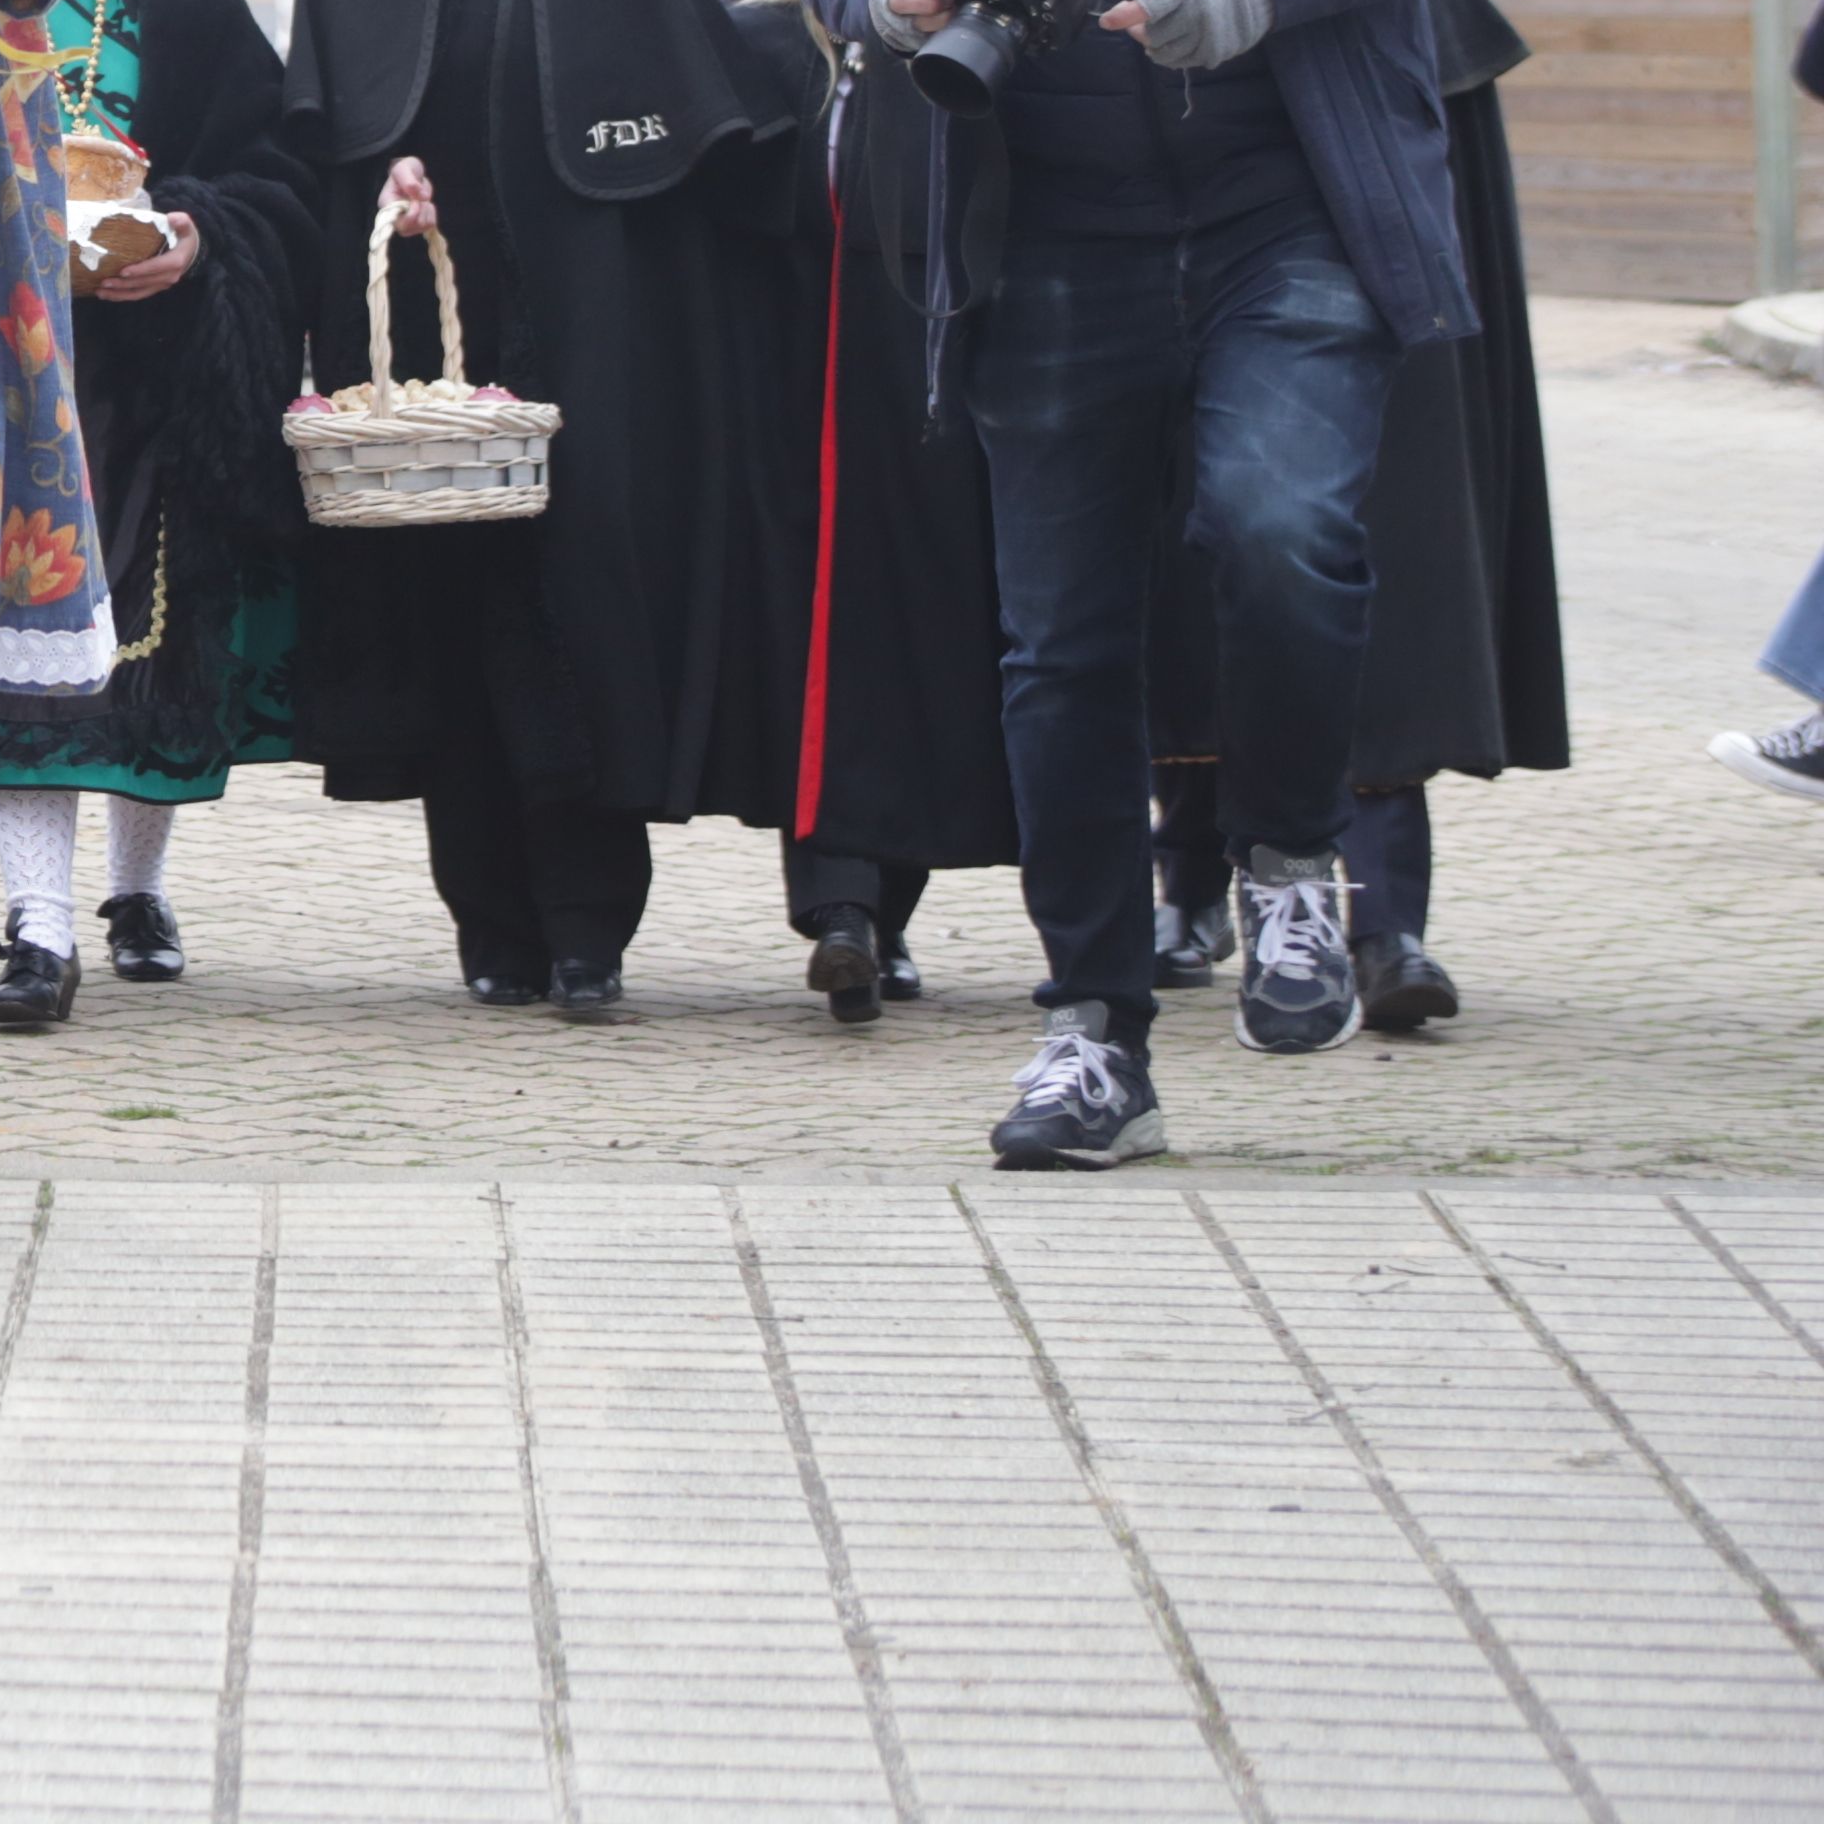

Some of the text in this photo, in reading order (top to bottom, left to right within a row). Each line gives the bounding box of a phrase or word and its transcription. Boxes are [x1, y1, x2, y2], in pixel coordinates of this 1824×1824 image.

[585, 114, 670, 153] FDR
[1283, 858, 1315, 874] 990
[1050, 1008, 1076, 1025] 990
